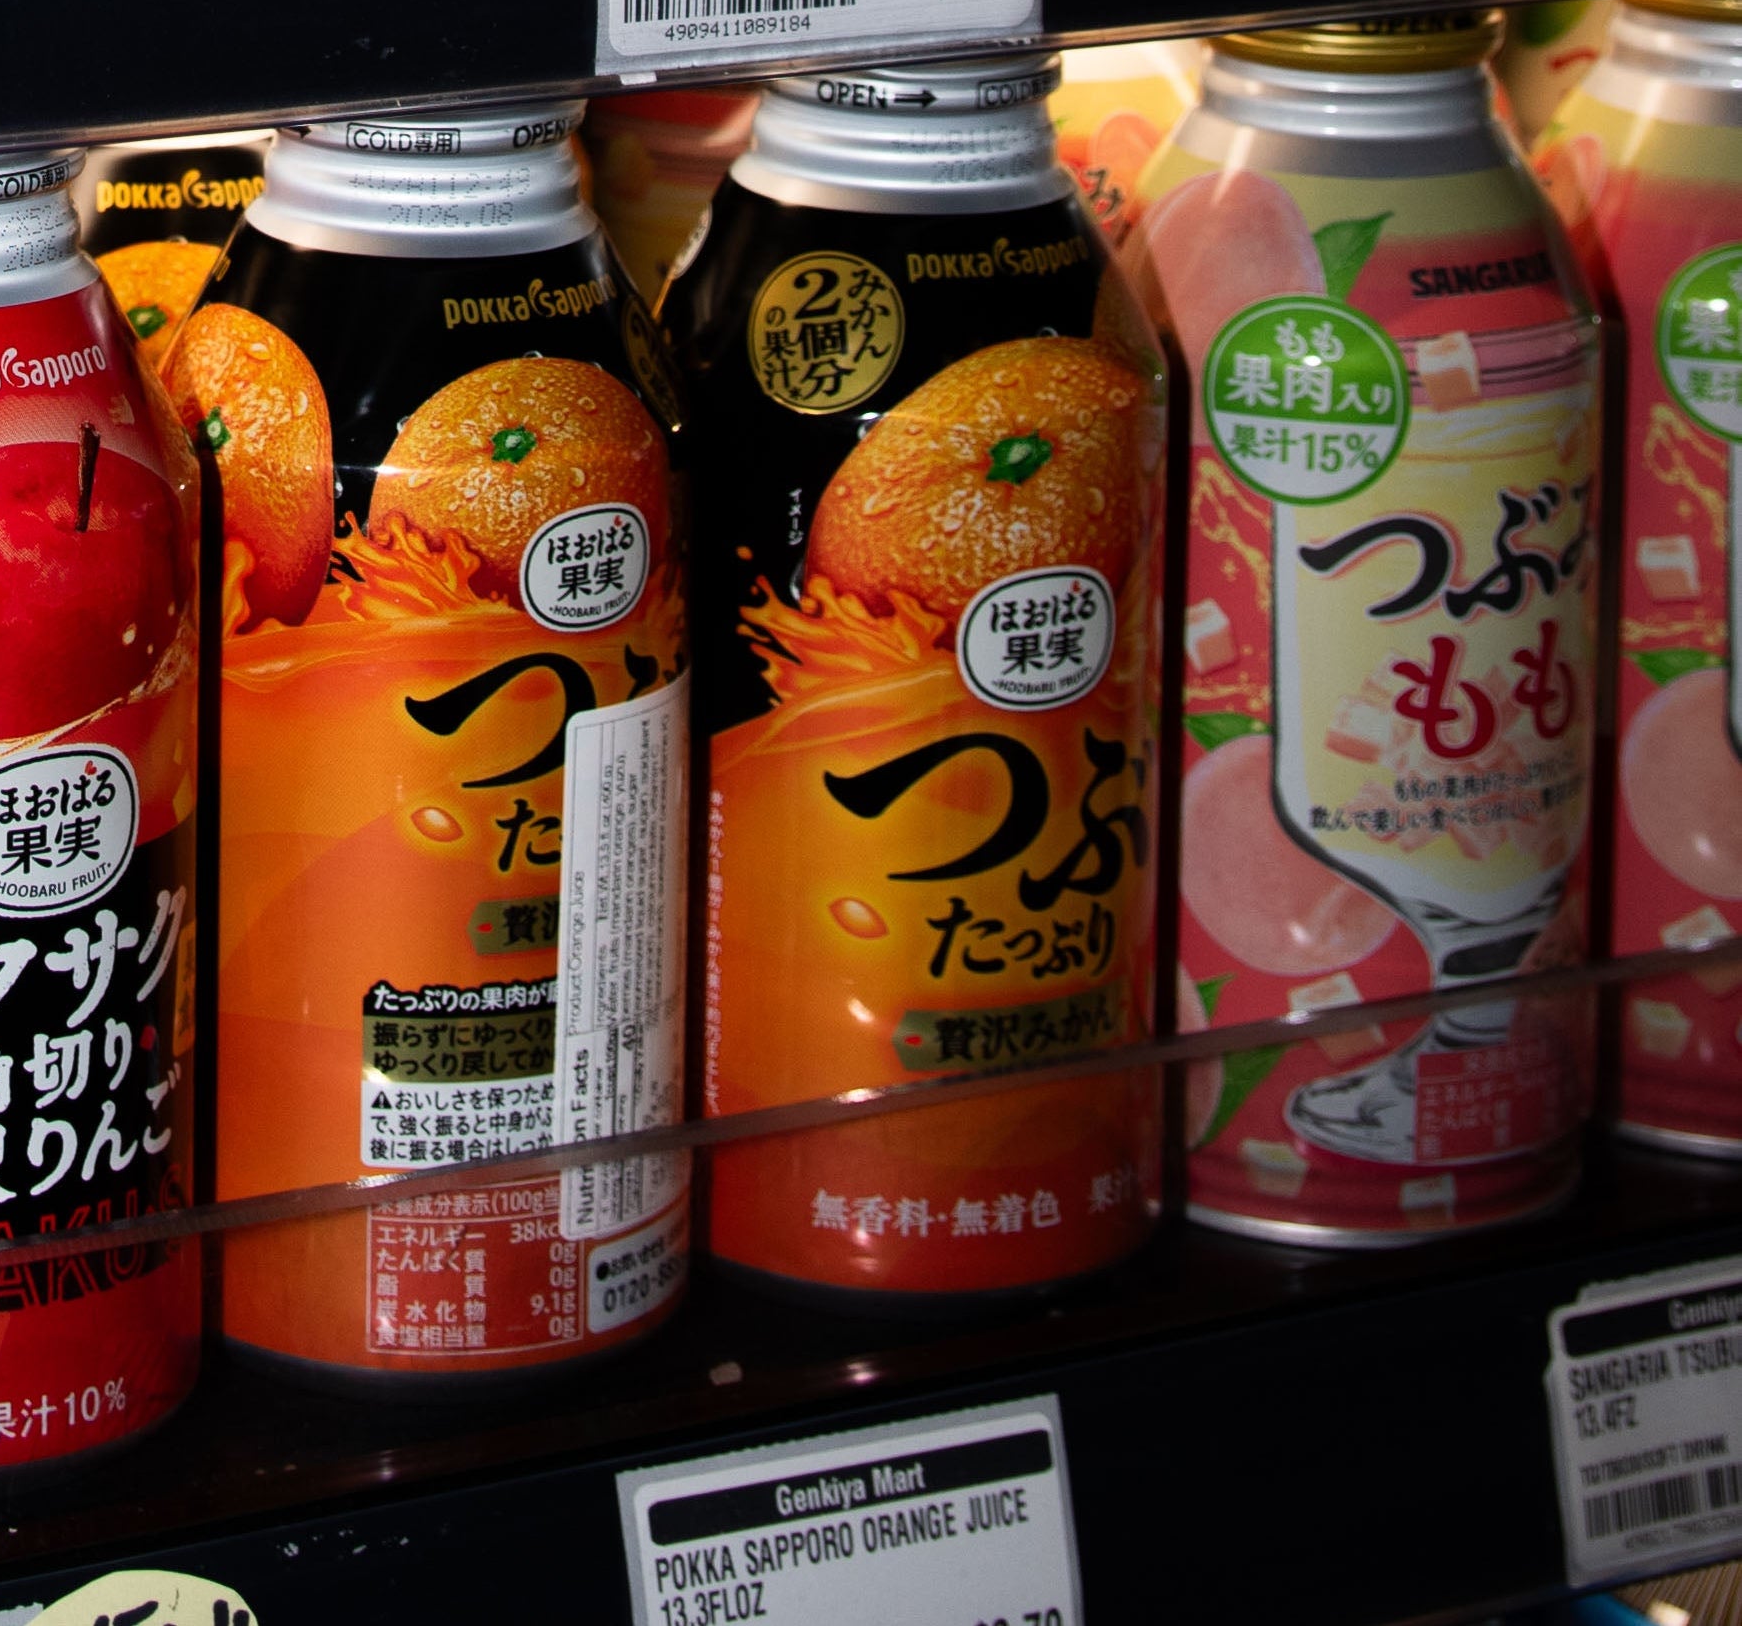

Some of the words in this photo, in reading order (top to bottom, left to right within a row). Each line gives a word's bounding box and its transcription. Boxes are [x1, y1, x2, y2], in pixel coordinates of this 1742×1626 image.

[664, 14, 812, 43] 4909411089184
[816, 79, 888, 109] OPEN
[353, 128, 454, 153] COLD専用
[512, 118, 569, 149] OPEN
[1409, 253, 1554, 300] SANGARIA
[1273, 317, 1345, 362] もも
[1225, 350, 1393, 417] 果肉入り
[1228, 424, 1380, 475] 果汁15%
[556, 557, 626, 602] 果実
[1001, 630, 1084, 675] 果実
[1392, 620, 1576, 760] もも
[2, 816, 101, 877] 果実
[70, 863, 110, 890] FRUIT
[926, 896, 1116, 980] たっぷり
[776, 1475, 867, 1516] Genkiya
[871, 1462, 925, 1497] Mart
[656, 1546, 737, 1593] POKKA
[746, 1522, 854, 1577] SAPPORO
[864, 1502, 957, 1554] ORANGE
[966, 1488, 1028, 1534] JUICE
